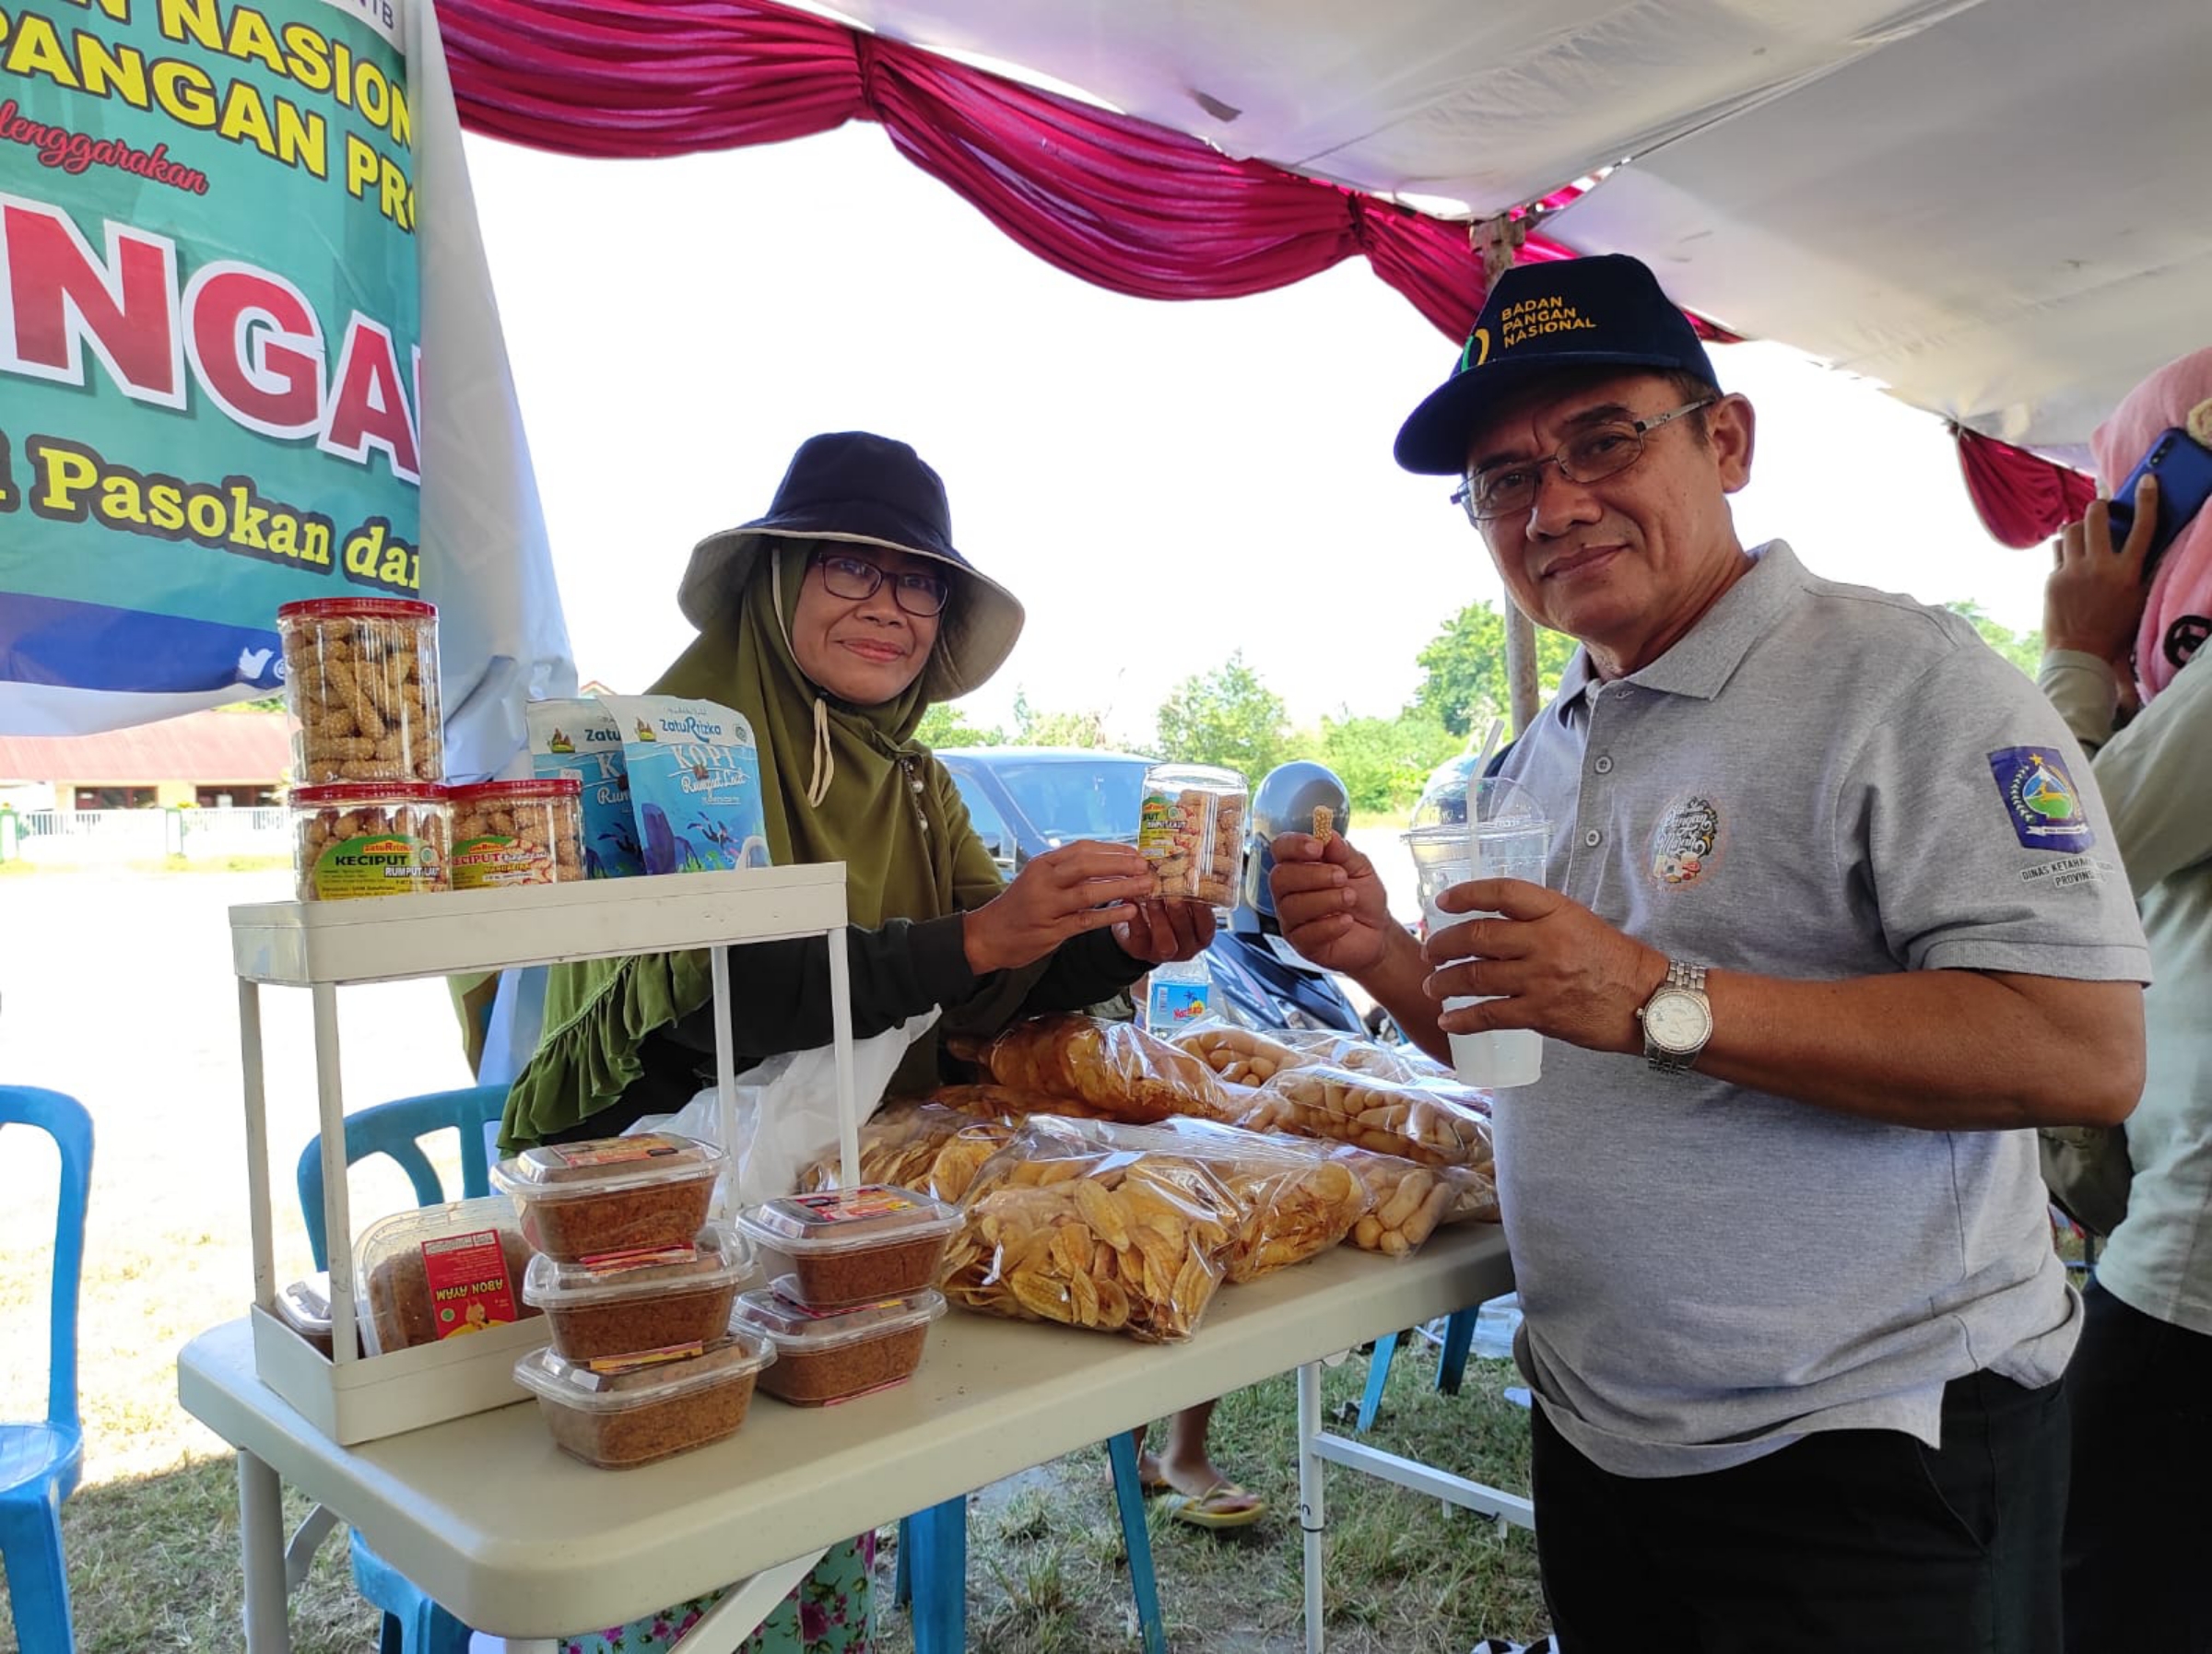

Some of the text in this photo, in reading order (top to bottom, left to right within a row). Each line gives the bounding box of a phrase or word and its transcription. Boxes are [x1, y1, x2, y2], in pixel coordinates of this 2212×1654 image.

[1501, 296, 1563, 322] BADAN
[1502, 307, 1577, 334] PANGAN
[0, 194, 420, 484] NGA
[1503, 317, 1597, 349] NASIONAL
[39, 446, 330, 565] Pasokan
[670, 745, 737, 769] KOPI
[335, 855, 408, 866] KECIPUT
[384, 866, 422, 877] RUMPUT
[2021, 865, 2051, 881] DINAS
[435, 1278, 503, 1301] ABON AYAM
